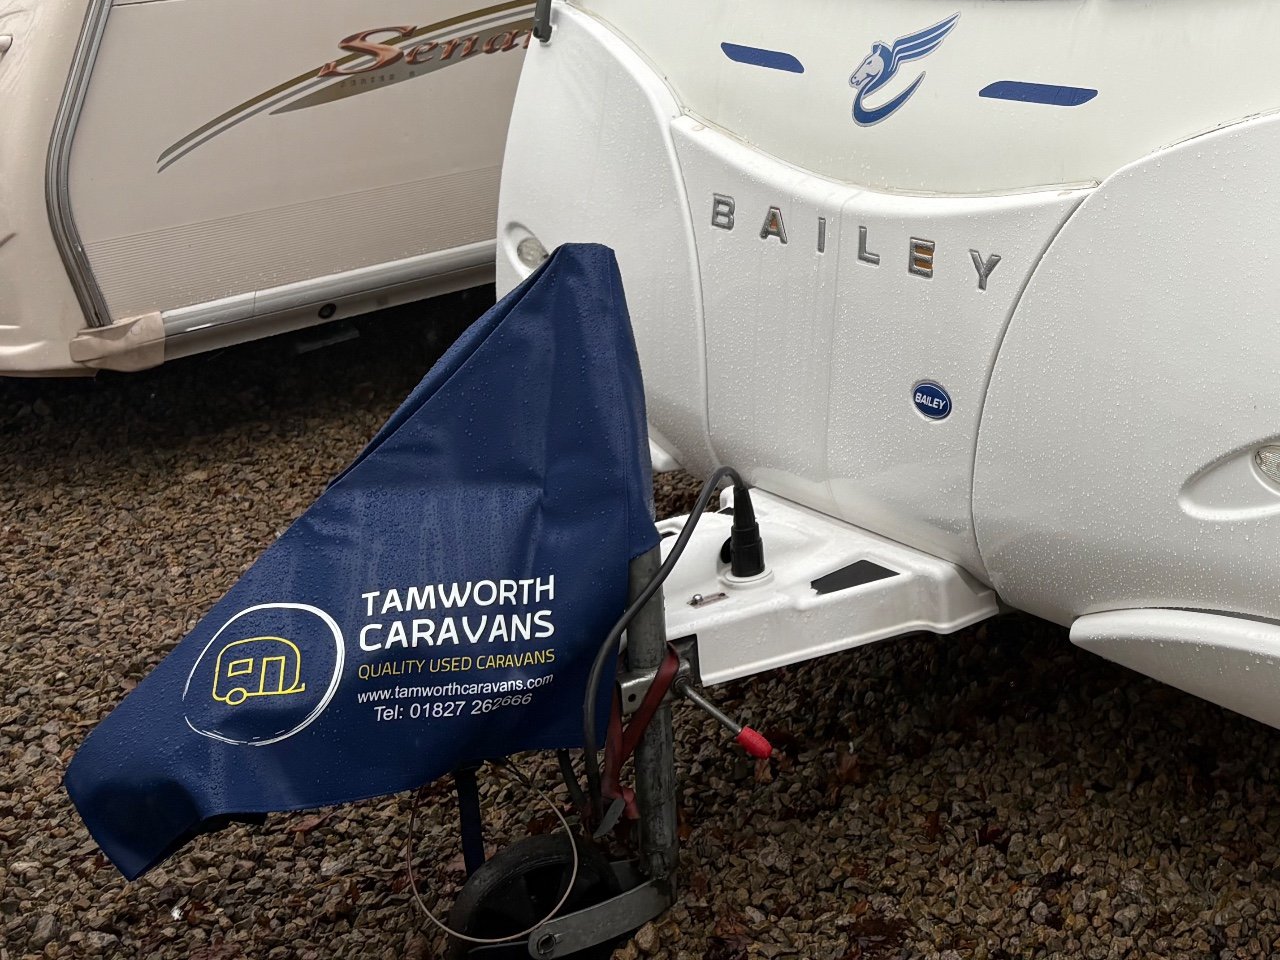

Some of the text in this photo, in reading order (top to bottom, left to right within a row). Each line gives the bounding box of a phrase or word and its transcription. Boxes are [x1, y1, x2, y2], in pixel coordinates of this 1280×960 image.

[711, 192, 1002, 291] BAILEY
[914, 392, 947, 410] BAILEY
[361, 574, 555, 617] TAMWORTH
[359, 610, 555, 652] CARAVANS
[358, 648, 555, 680] QUALITY USED CARAVANS
[357, 673, 554, 704] www.tamworthcaravans.com
[373, 693, 533, 722] Tel: 01827 262666
